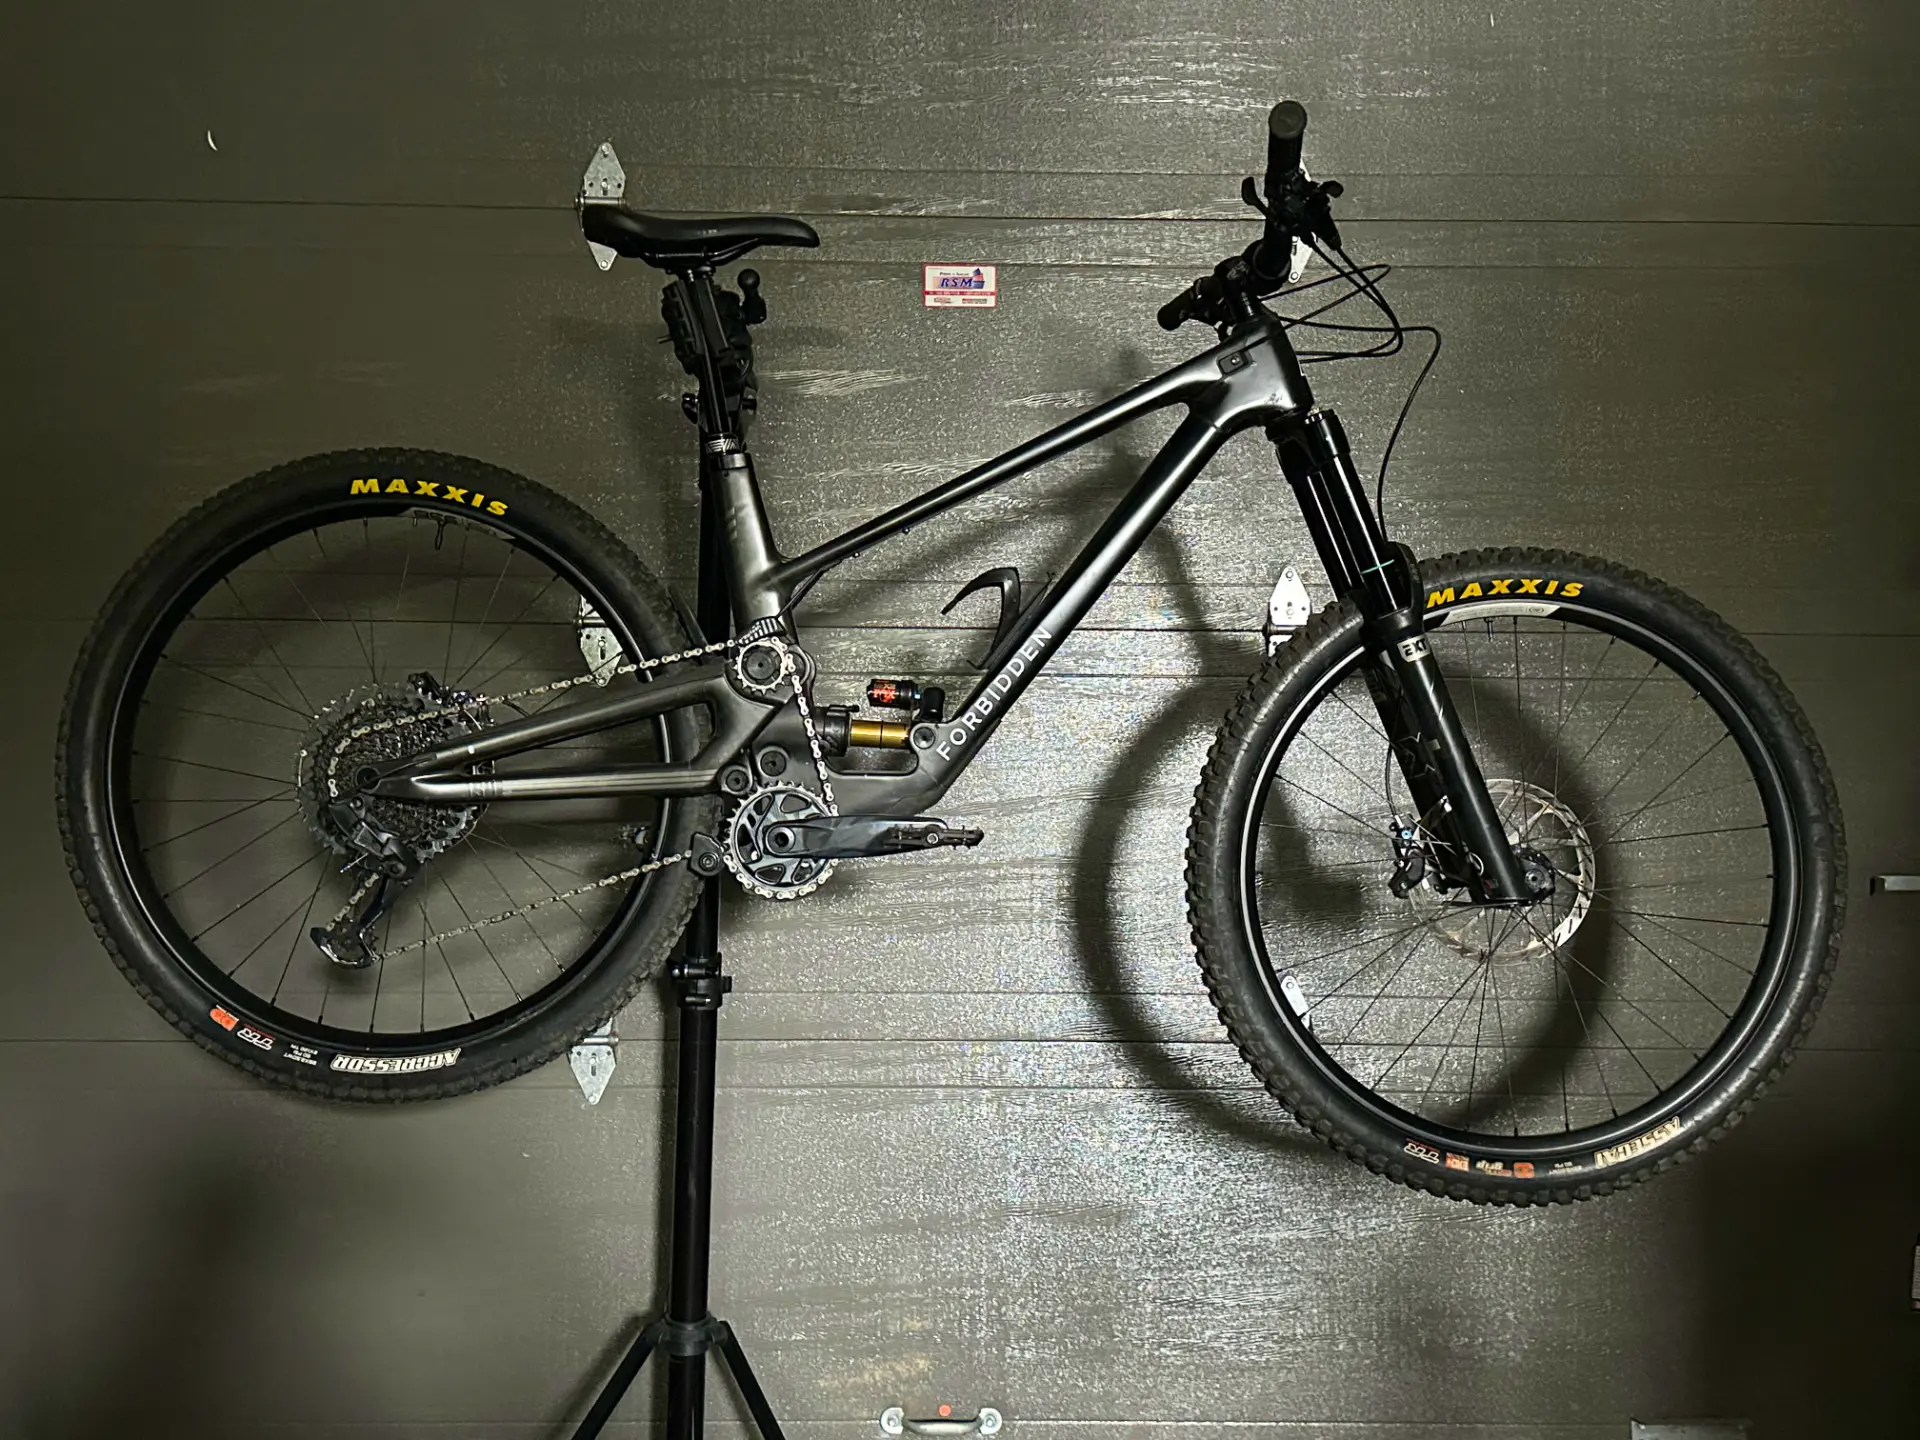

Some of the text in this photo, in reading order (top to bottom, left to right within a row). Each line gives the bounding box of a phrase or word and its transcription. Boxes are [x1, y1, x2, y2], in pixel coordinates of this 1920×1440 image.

[941, 278, 973, 288] RSM
[350, 479, 509, 516] MAXXIS
[1426, 579, 1584, 608] MAXXIS
[1402, 638, 1427, 657] EXT
[936, 626, 1053, 761] FORBIDDEN
[330, 1048, 461, 1074] AGGRESSOR
[1594, 1116, 1681, 1169] ASSEGAI
